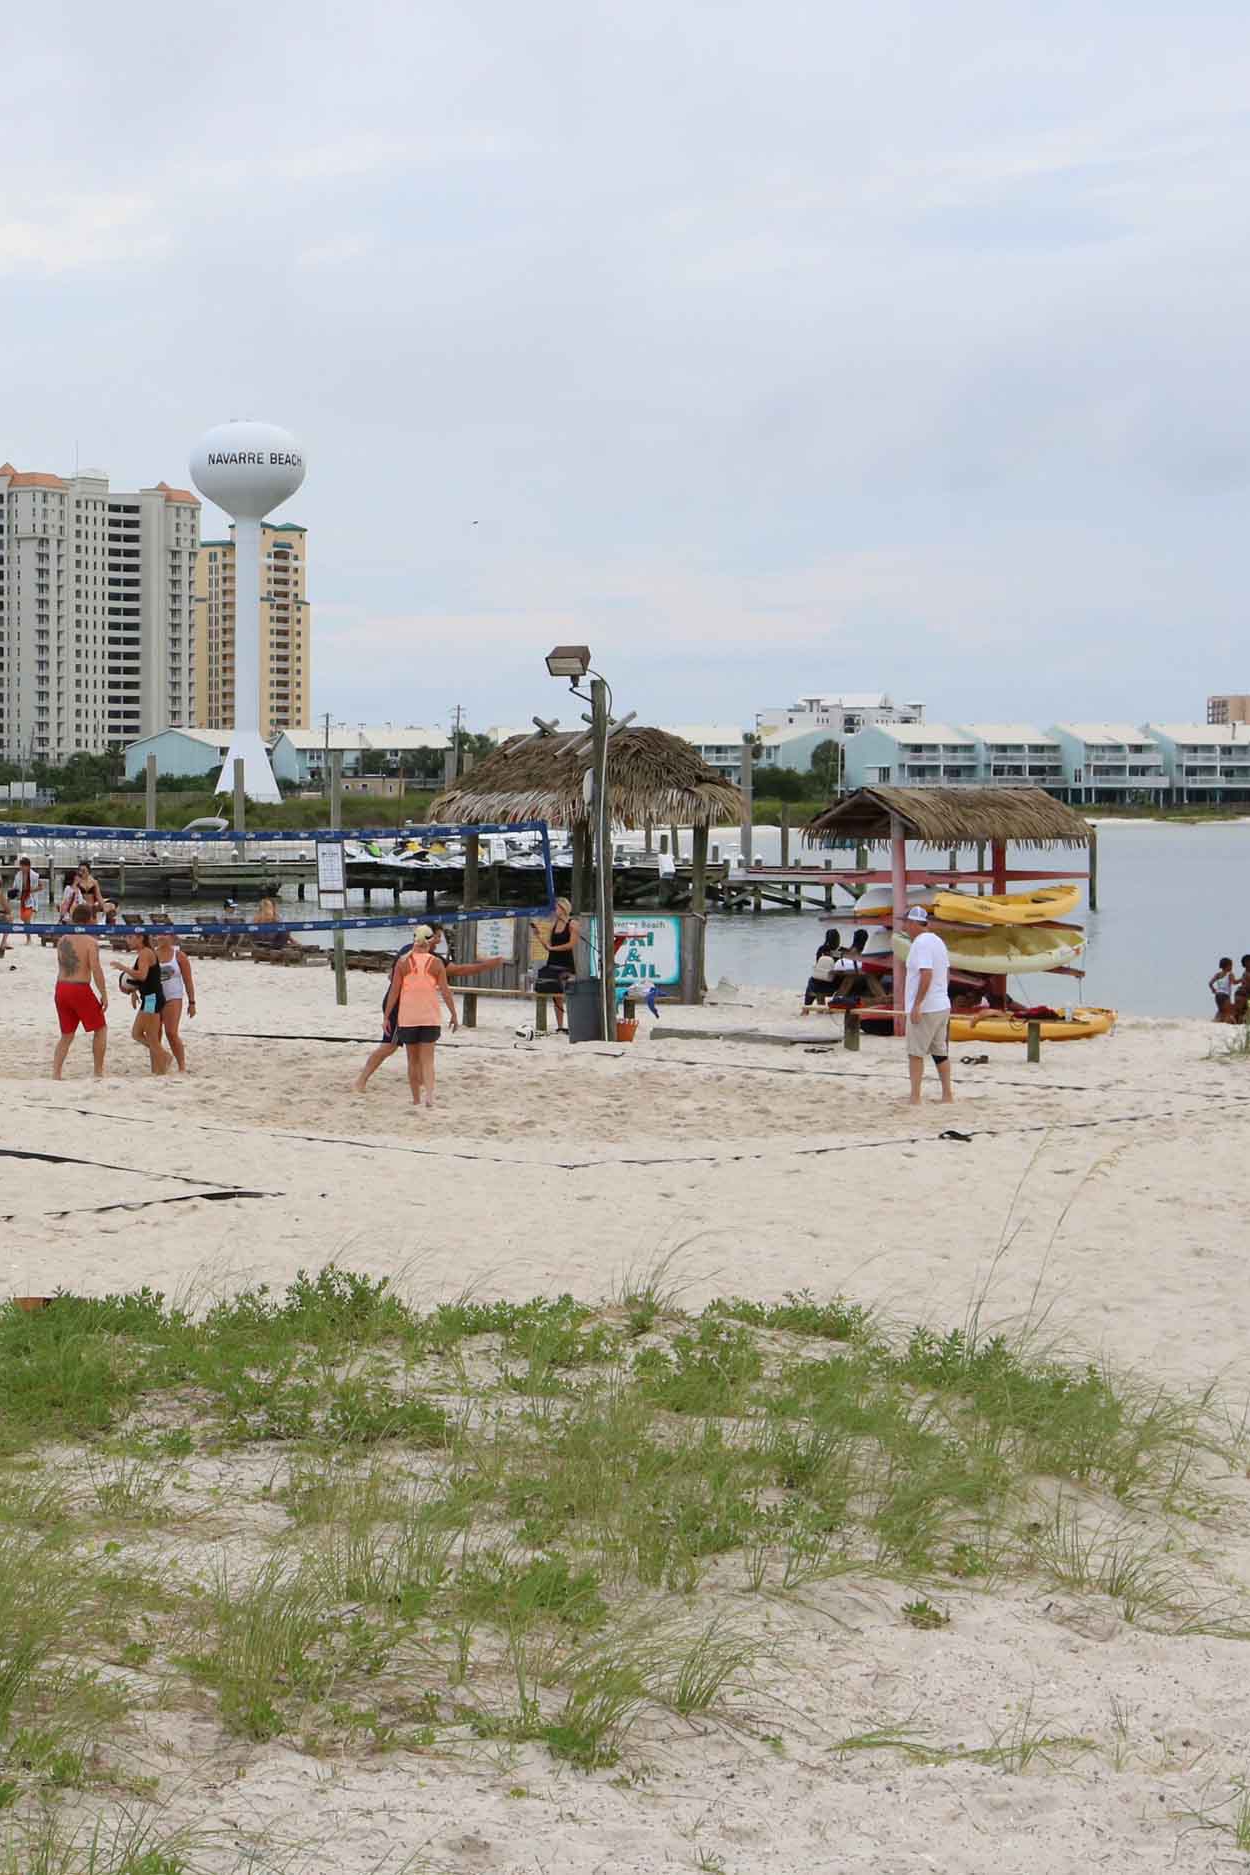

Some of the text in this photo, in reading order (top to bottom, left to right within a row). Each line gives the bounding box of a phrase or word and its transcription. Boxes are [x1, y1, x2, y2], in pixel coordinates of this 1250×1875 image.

[208, 452, 302, 467] NAVARRE BEACH
[641, 919, 666, 928] Beach
[627, 948, 640, 962] &
